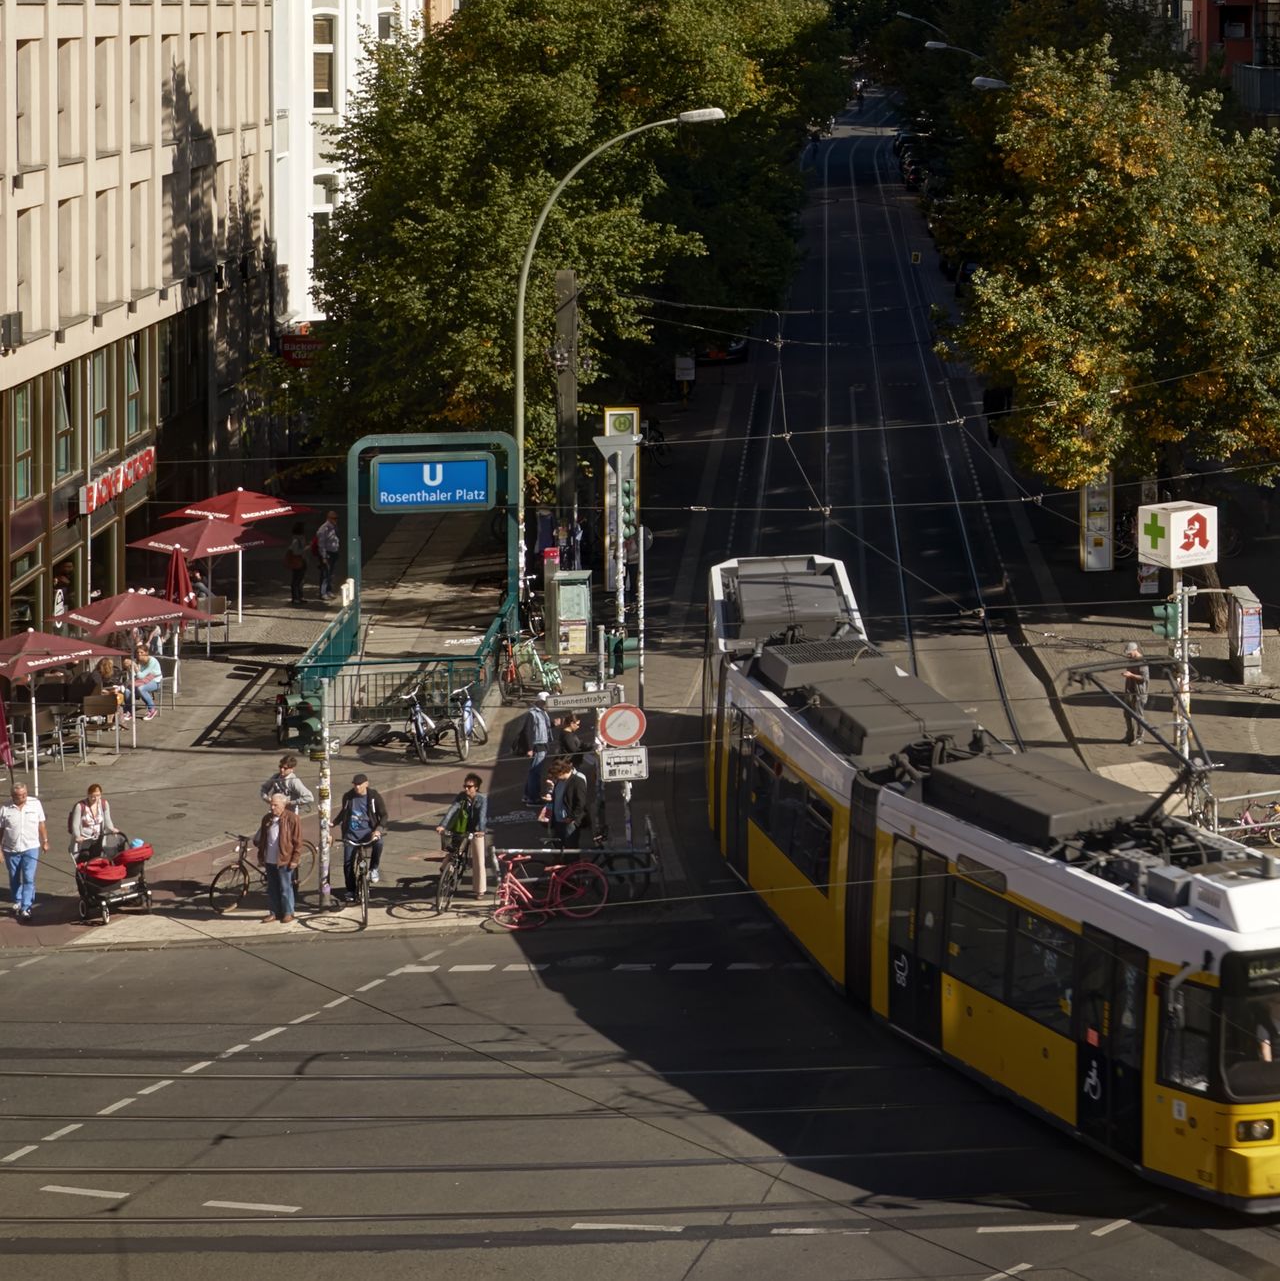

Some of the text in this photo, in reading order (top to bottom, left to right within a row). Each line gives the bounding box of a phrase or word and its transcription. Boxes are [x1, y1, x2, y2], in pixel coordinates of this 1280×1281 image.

[423, 463, 443, 487] U
[380, 489, 485, 503] Rosenthaler Platz
[553, 695, 607, 706] Brunnenstraße
